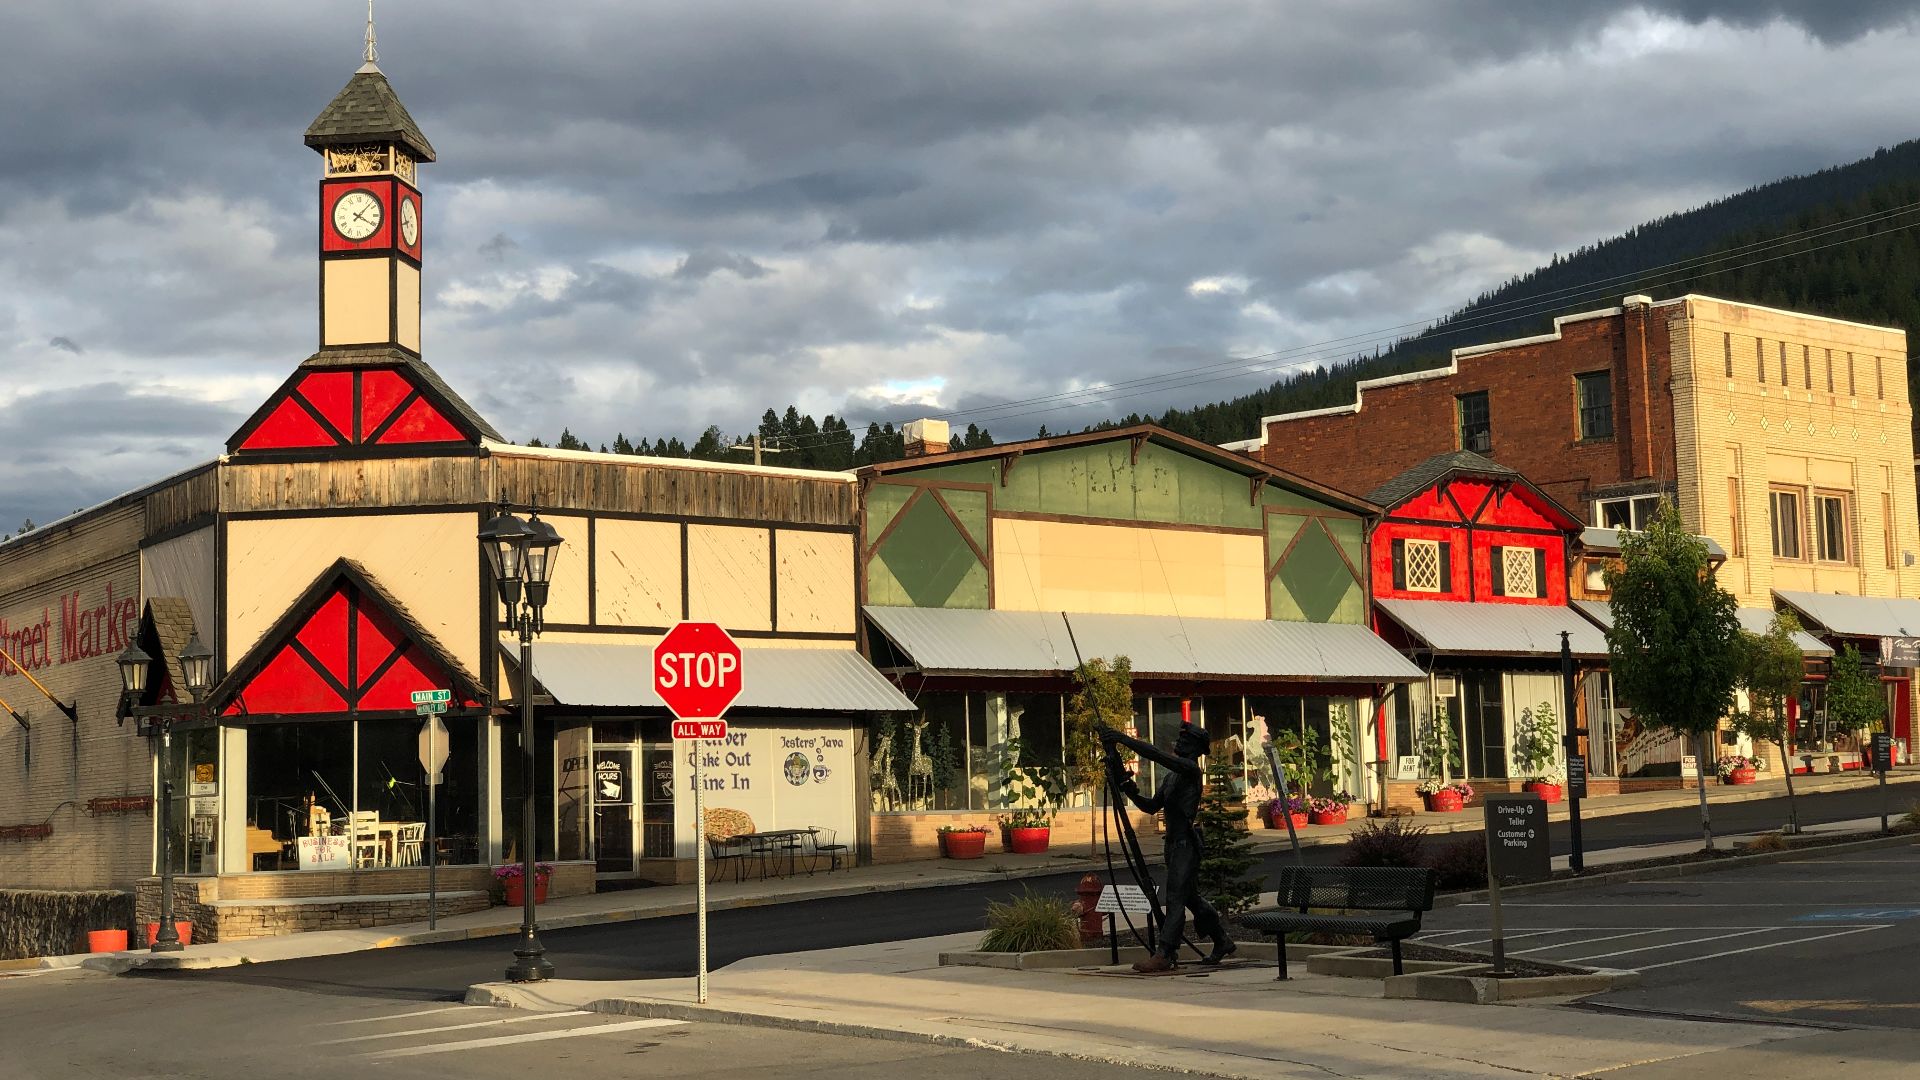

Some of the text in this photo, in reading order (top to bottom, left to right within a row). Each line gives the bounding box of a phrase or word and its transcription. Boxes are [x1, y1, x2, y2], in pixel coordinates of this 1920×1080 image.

[60, 581, 139, 664] Marke
[659, 652, 737, 689] STOP
[415, 691, 447, 702] MAIN ST
[678, 725, 722, 736] ALL WAY
[820, 735, 844, 749] Java
[725, 751, 752, 767] Out
[1405, 757, 1415, 765] FOR
[597, 760, 621, 771] WELCOME
[1402, 764, 1416, 772] RENT
[598, 772, 618, 781] HOURS
[731, 773, 750, 790] In
[1498, 805, 1525, 815] Drive-Up
[1509, 817, 1525, 826] Teller
[1497, 830, 1527, 838] Customer
[302, 837, 345, 848] BUSINESS
[1503, 839, 1528, 849] Parking
[315, 846, 332, 855] FOR
[312, 853, 335, 863] SALE
